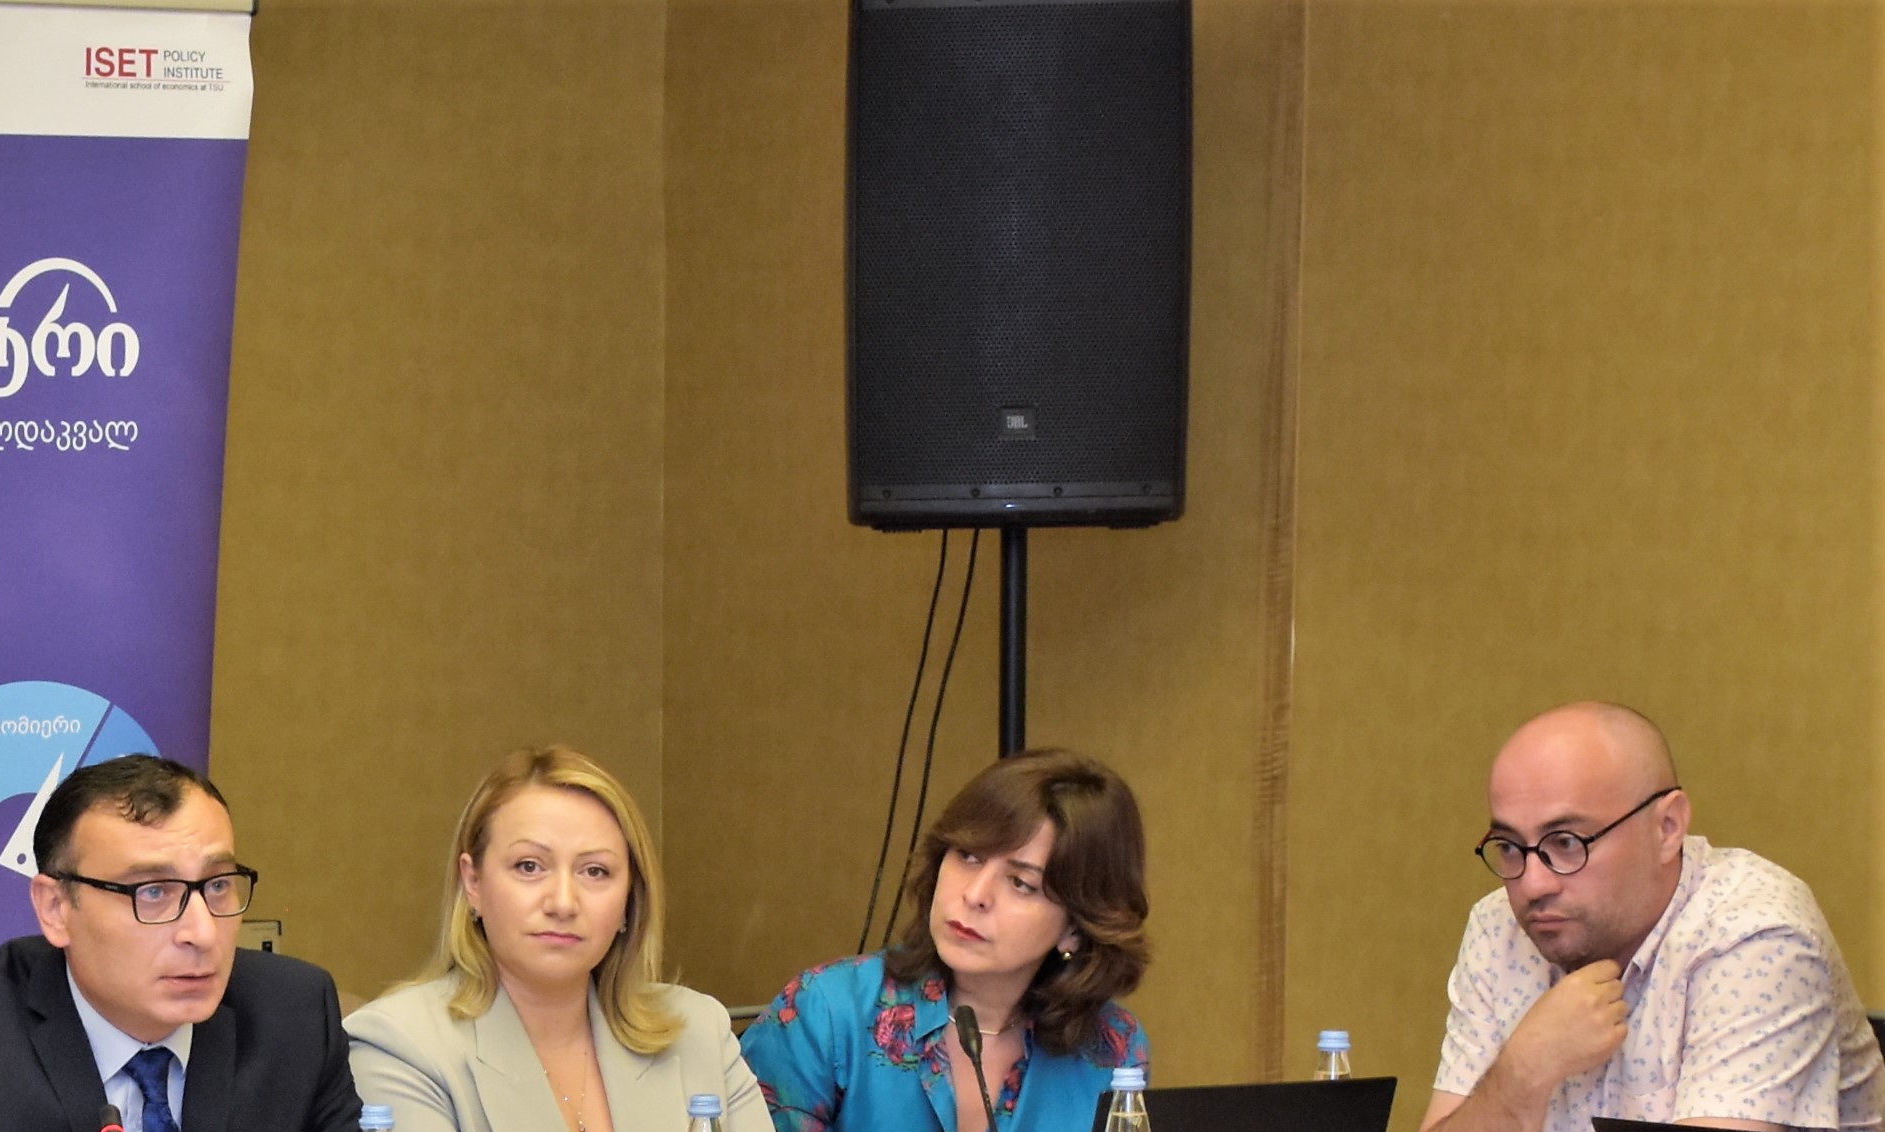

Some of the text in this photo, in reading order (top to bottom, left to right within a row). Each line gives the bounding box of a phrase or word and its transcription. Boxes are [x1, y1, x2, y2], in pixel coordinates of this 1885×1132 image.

[163, 50, 206, 62] POLICY
[85, 47, 158, 78] ISET
[163, 67, 223, 79] INSTITUTE
